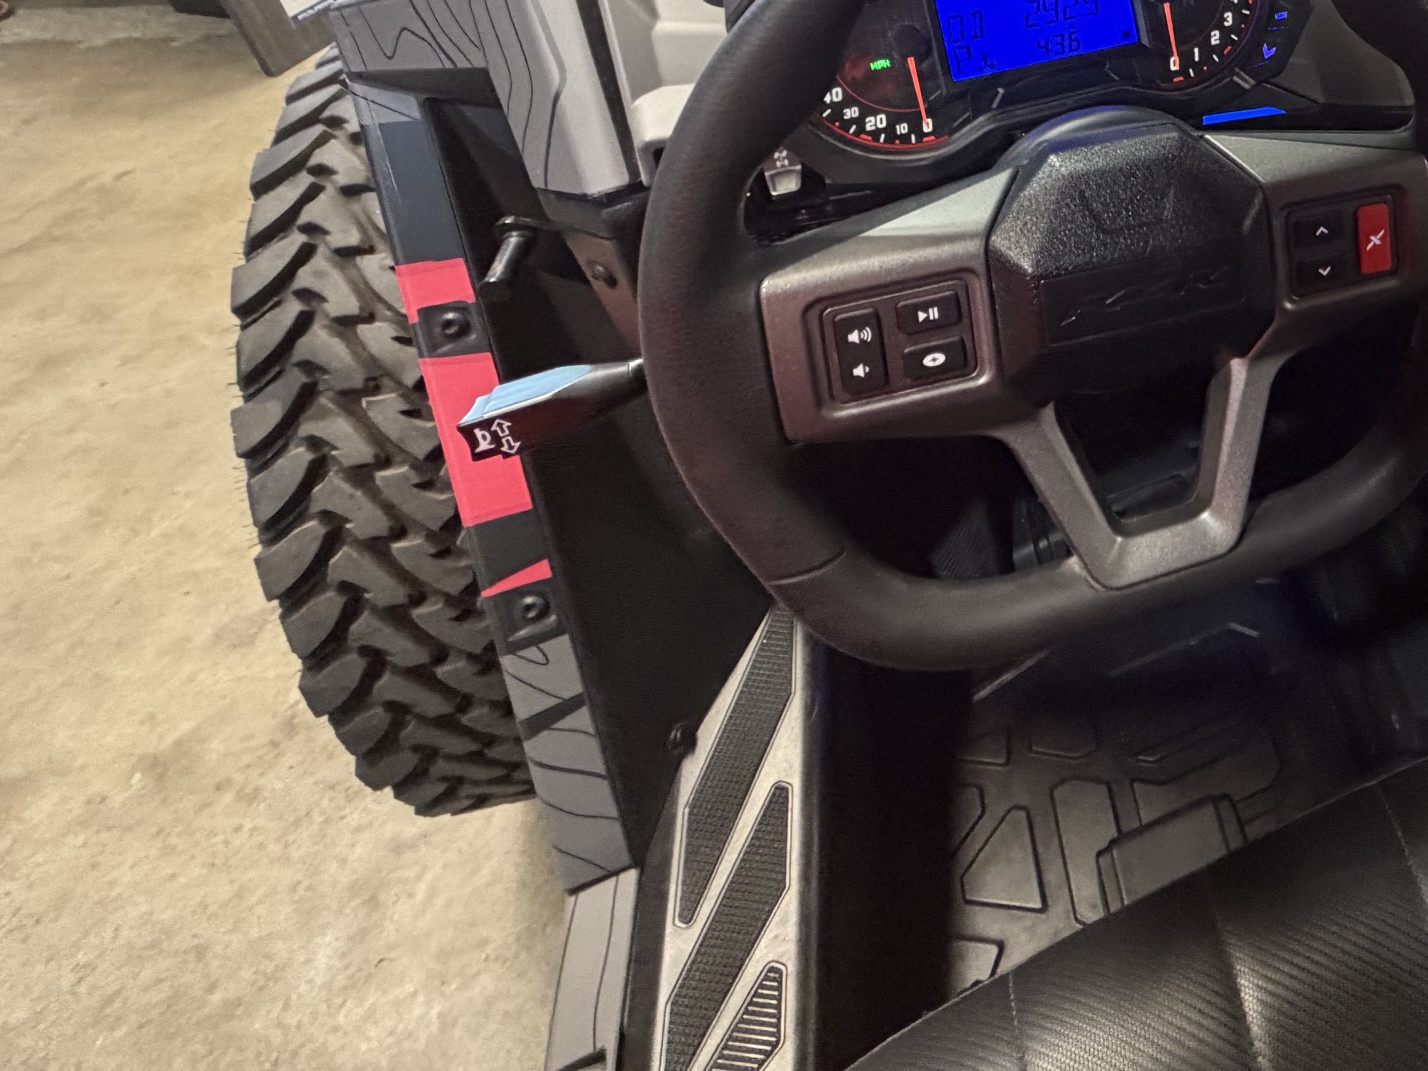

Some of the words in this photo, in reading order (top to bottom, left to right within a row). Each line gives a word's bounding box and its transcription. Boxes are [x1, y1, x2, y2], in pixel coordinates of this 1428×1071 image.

[1223, 11, 1233, 27] 3
[1210, 30, 1221, 46] 2
[1194, 47, 1199, 62] 1
[870, 59, 891, 71] MPH
[1170, 56, 1180, 71] 0
[823, 87, 843, 104] 40
[843, 106, 859, 119] 30
[865, 114, 887, 131] 20
[896, 123, 909, 135] 10
[923, 119, 933, 133] 0
